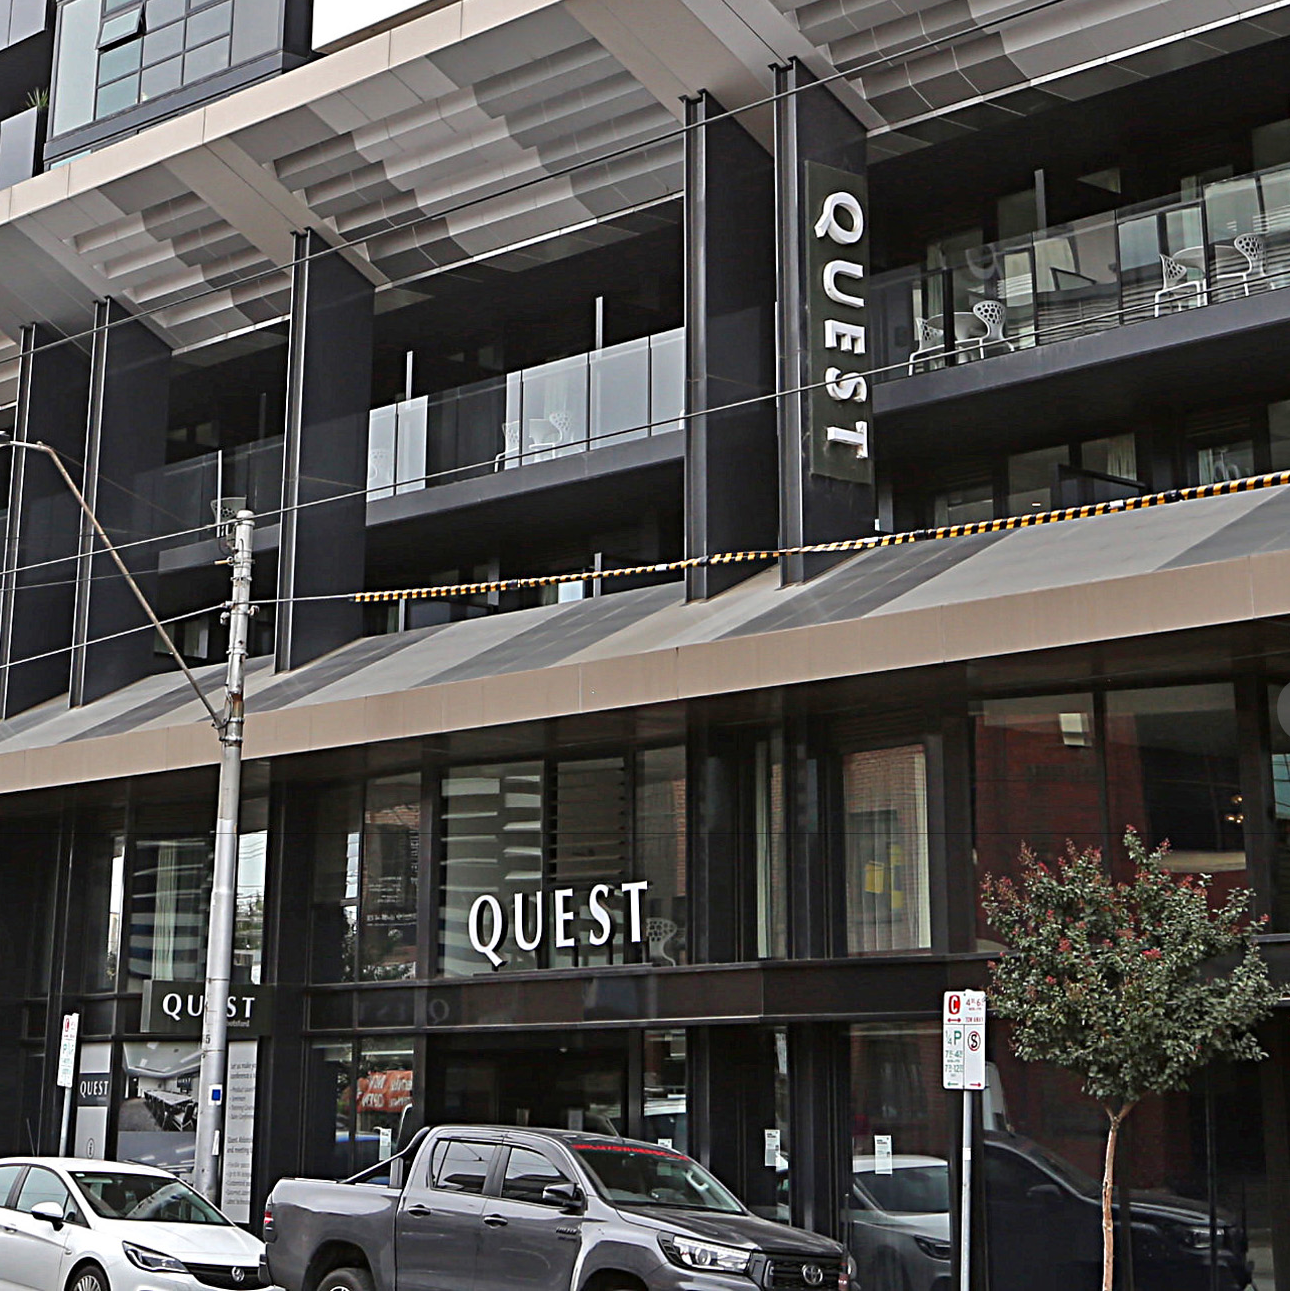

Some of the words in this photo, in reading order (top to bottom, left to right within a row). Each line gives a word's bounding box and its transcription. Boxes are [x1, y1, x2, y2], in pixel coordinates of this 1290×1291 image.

[814, 191, 868, 460] QUEST
[468, 881, 648, 967] QUEST
[162, 993, 255, 1021] QUST
[79, 1080, 109, 1098] QUEST
